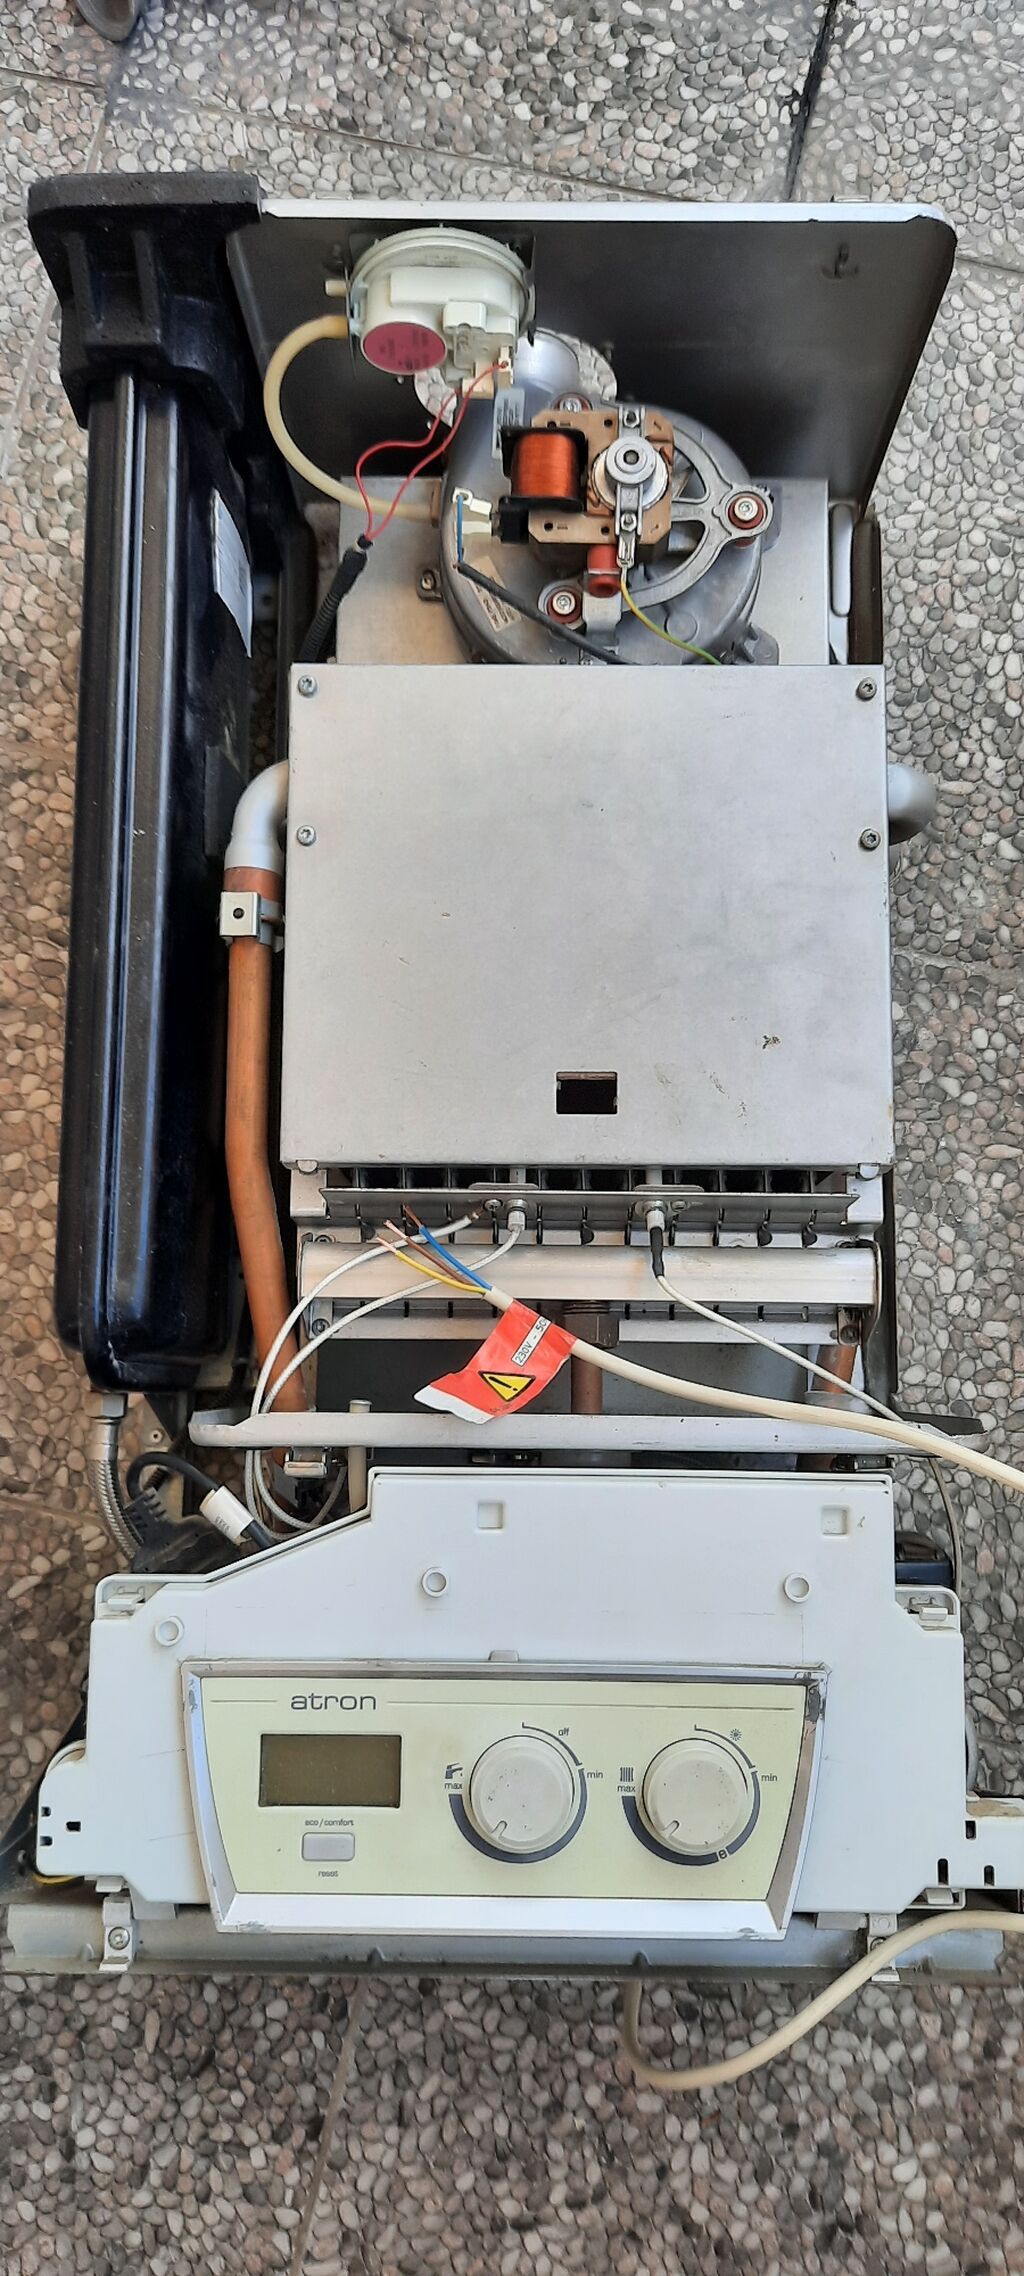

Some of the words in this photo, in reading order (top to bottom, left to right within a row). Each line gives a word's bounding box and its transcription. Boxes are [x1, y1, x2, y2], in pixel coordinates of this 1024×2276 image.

[514, 1341, 532, 1363] 230V
[291, 1692, 377, 1710] atron
[558, 1727, 570, 1736] off
[586, 1770, 604, 1779] min
[761, 1774, 778, 1782] min
[444, 1782, 463, 1790] max
[617, 1784, 636, 1793] max
[318, 1870, 339, 1878] reset
